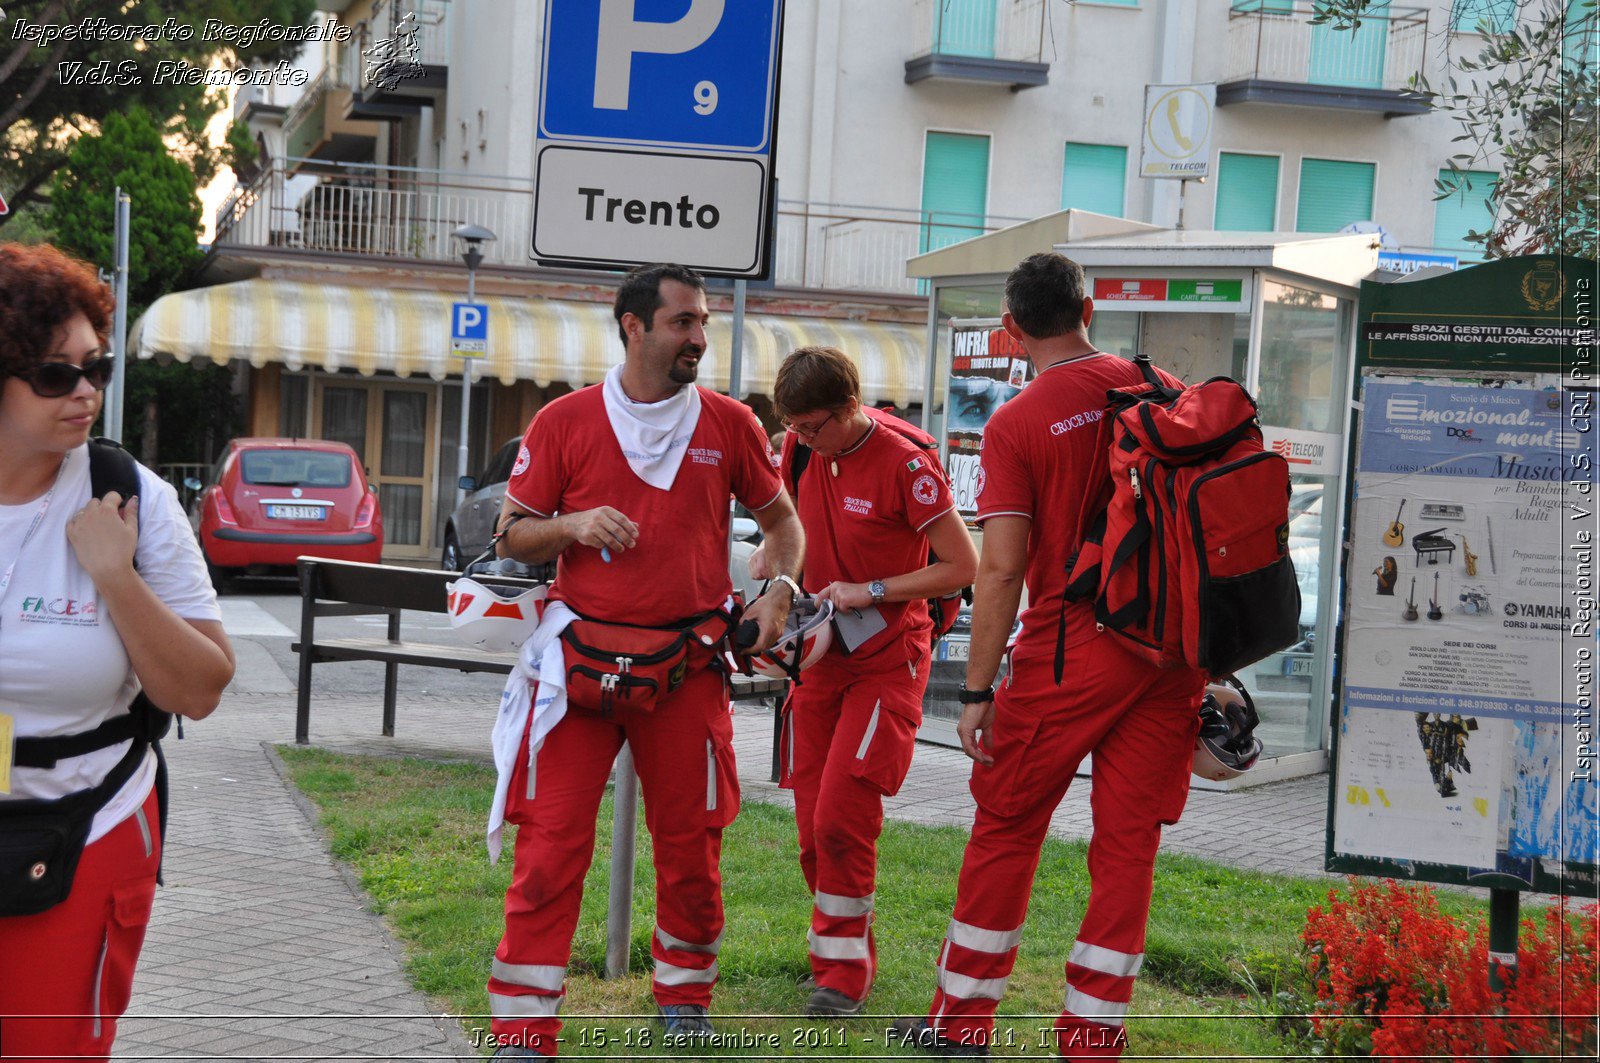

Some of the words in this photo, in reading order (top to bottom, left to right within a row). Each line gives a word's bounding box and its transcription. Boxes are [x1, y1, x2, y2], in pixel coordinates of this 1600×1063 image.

[693, 80, 719, 116] 9
[1170, 162, 1207, 171] TELECOM
[578, 187, 720, 230] Trento
[458, 306, 482, 336] P
[1412, 324, 1449, 333] SPAZI
[1453, 326, 1501, 334] GESTITI
[1505, 327, 1530, 335] DAL
[1368, 332, 1382, 340] LE
[1385, 333, 1451, 342] AFFISSIONI
[1455, 335, 1482, 343] NON
[1485, 336, 1568, 345] AUTORIZZATE
[971, 358, 992, 369] TRIBUTE
[993, 357, 1009, 368] BAND
[1450, 394, 1479, 404] Scuole
[1480, 395, 1488, 405] di
[1491, 396, 1521, 405] Musica
[1050, 414, 1085, 436] CROCE
[1394, 427, 1431, 436] Giuseppe
[1292, 442, 1325, 458] TELECOM
[1390, 464, 1419, 472] CORSI
[1423, 465, 1463, 475] YAMAHA
[1467, 467, 1479, 475] DI
[1490, 455, 1579, 481] Musica
[1494, 485, 1511, 495] per
[1511, 508, 1549, 521] Adulti
[22, 597, 79, 615] FACE
[1520, 603, 1571, 619] YAMAHA
[1503, 620, 1527, 629] CORSI
[1530, 622, 1538, 630] DI
[1541, 623, 1571, 632] MUSICA
[1350, 690, 1394, 702] Informazioni
[1440, 697, 1456, 707] Cell.
[1515, 703, 1531, 713] Cell.
